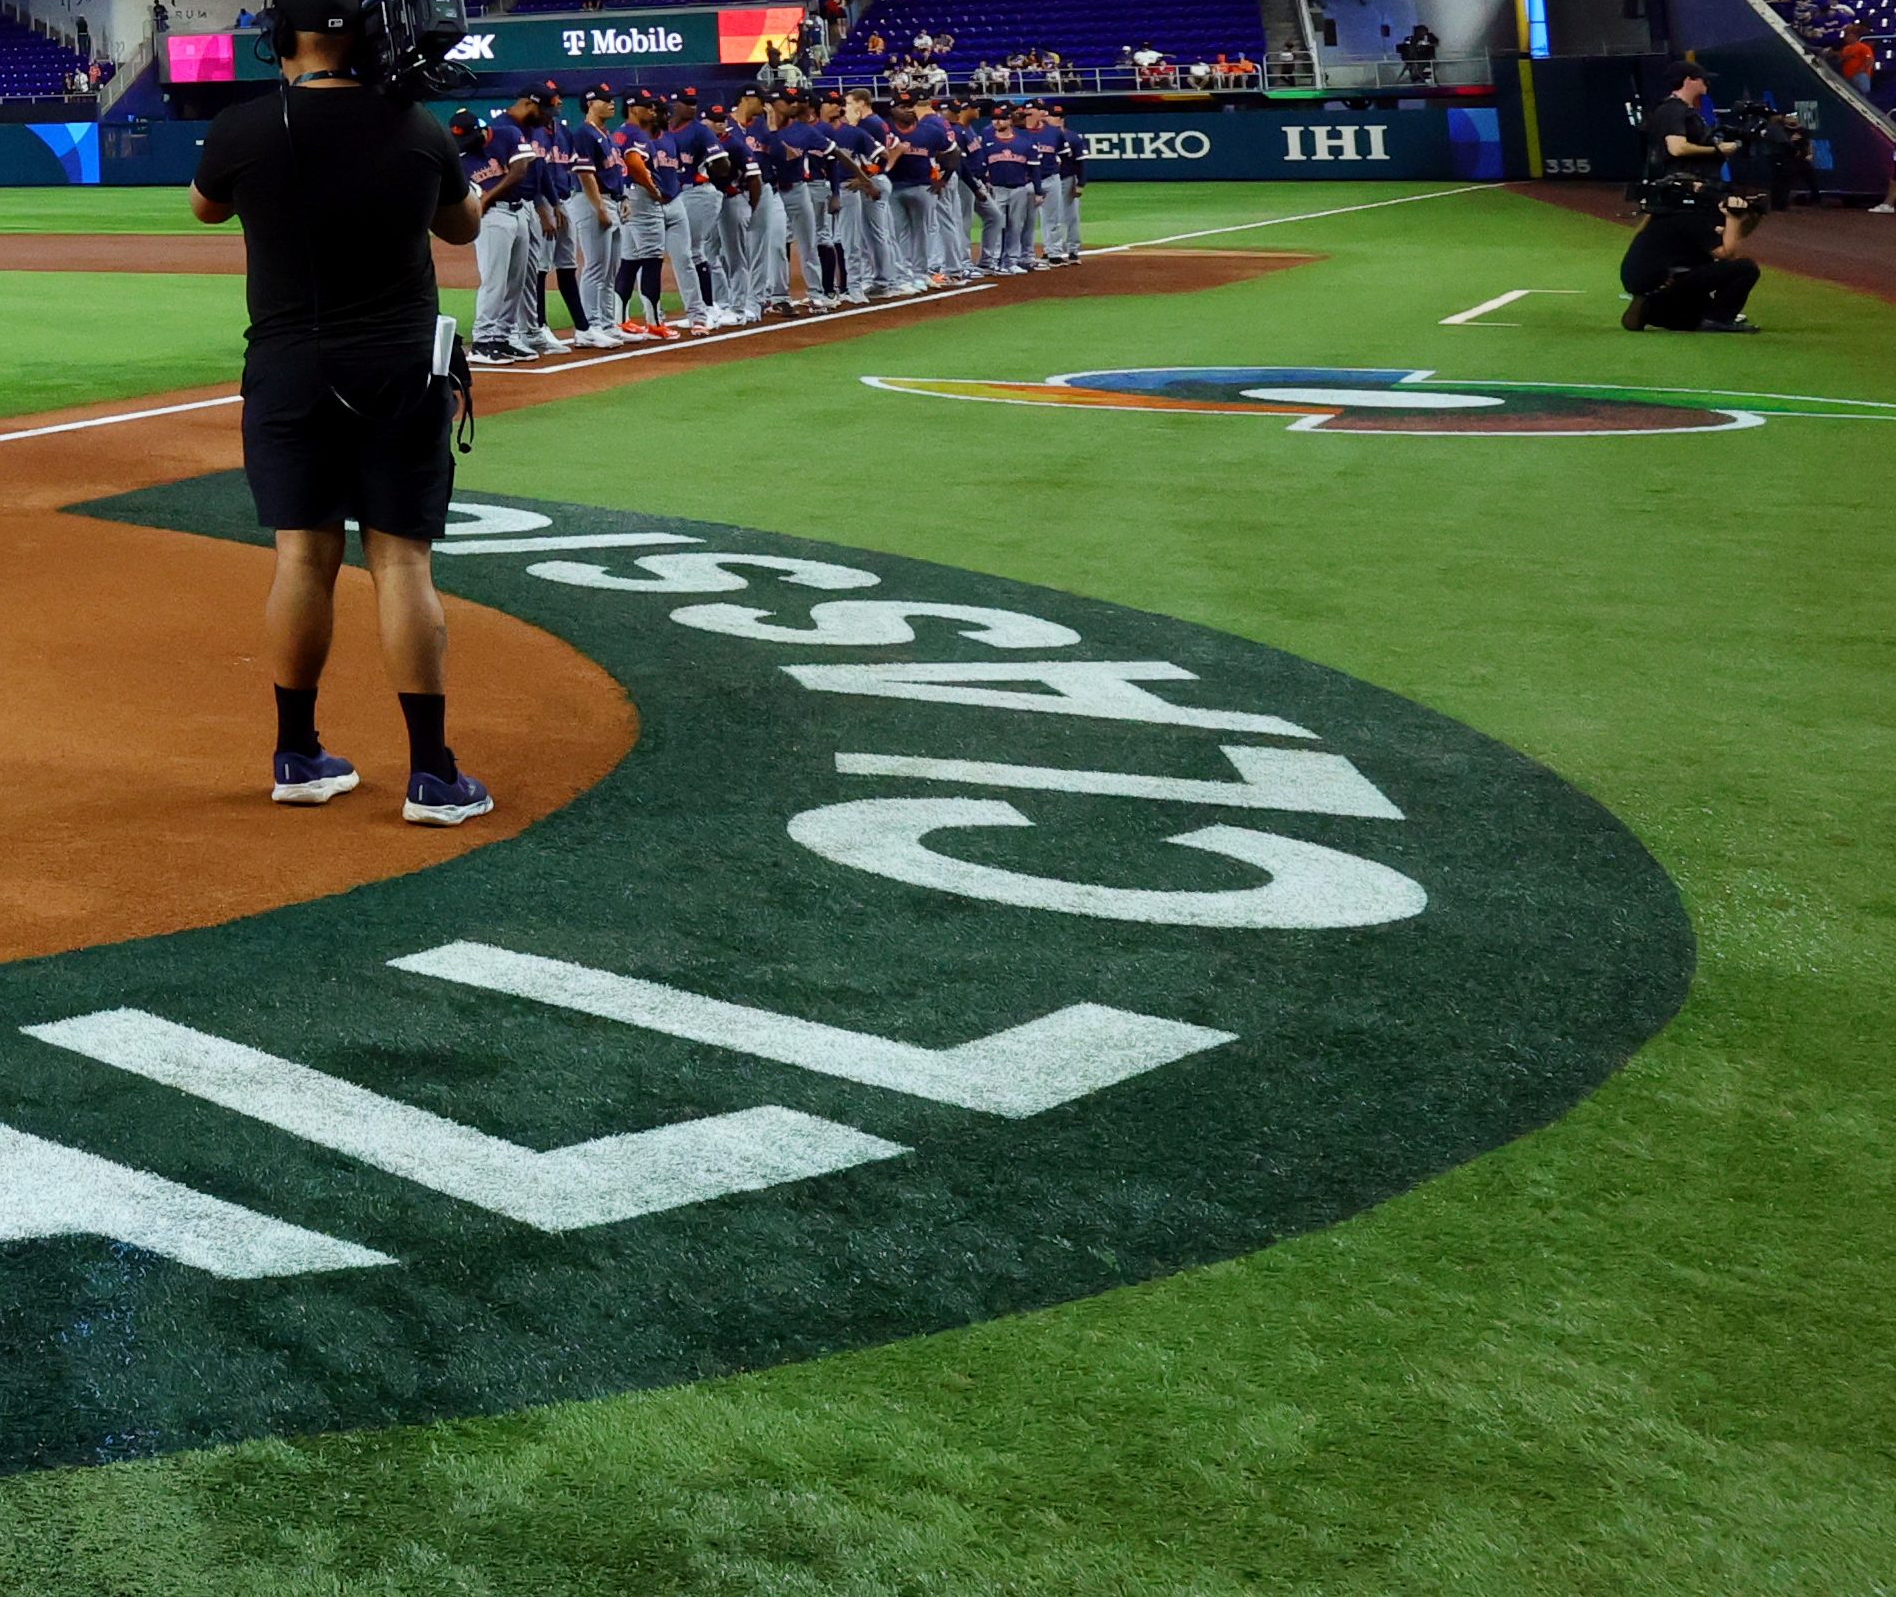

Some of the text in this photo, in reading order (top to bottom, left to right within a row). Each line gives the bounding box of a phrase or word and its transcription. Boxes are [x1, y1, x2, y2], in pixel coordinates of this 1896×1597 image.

[591, 26, 683, 54] Mobile
[1078, 125, 1391, 161] EIKO IHI
[1545, 158, 1591, 174] 335
